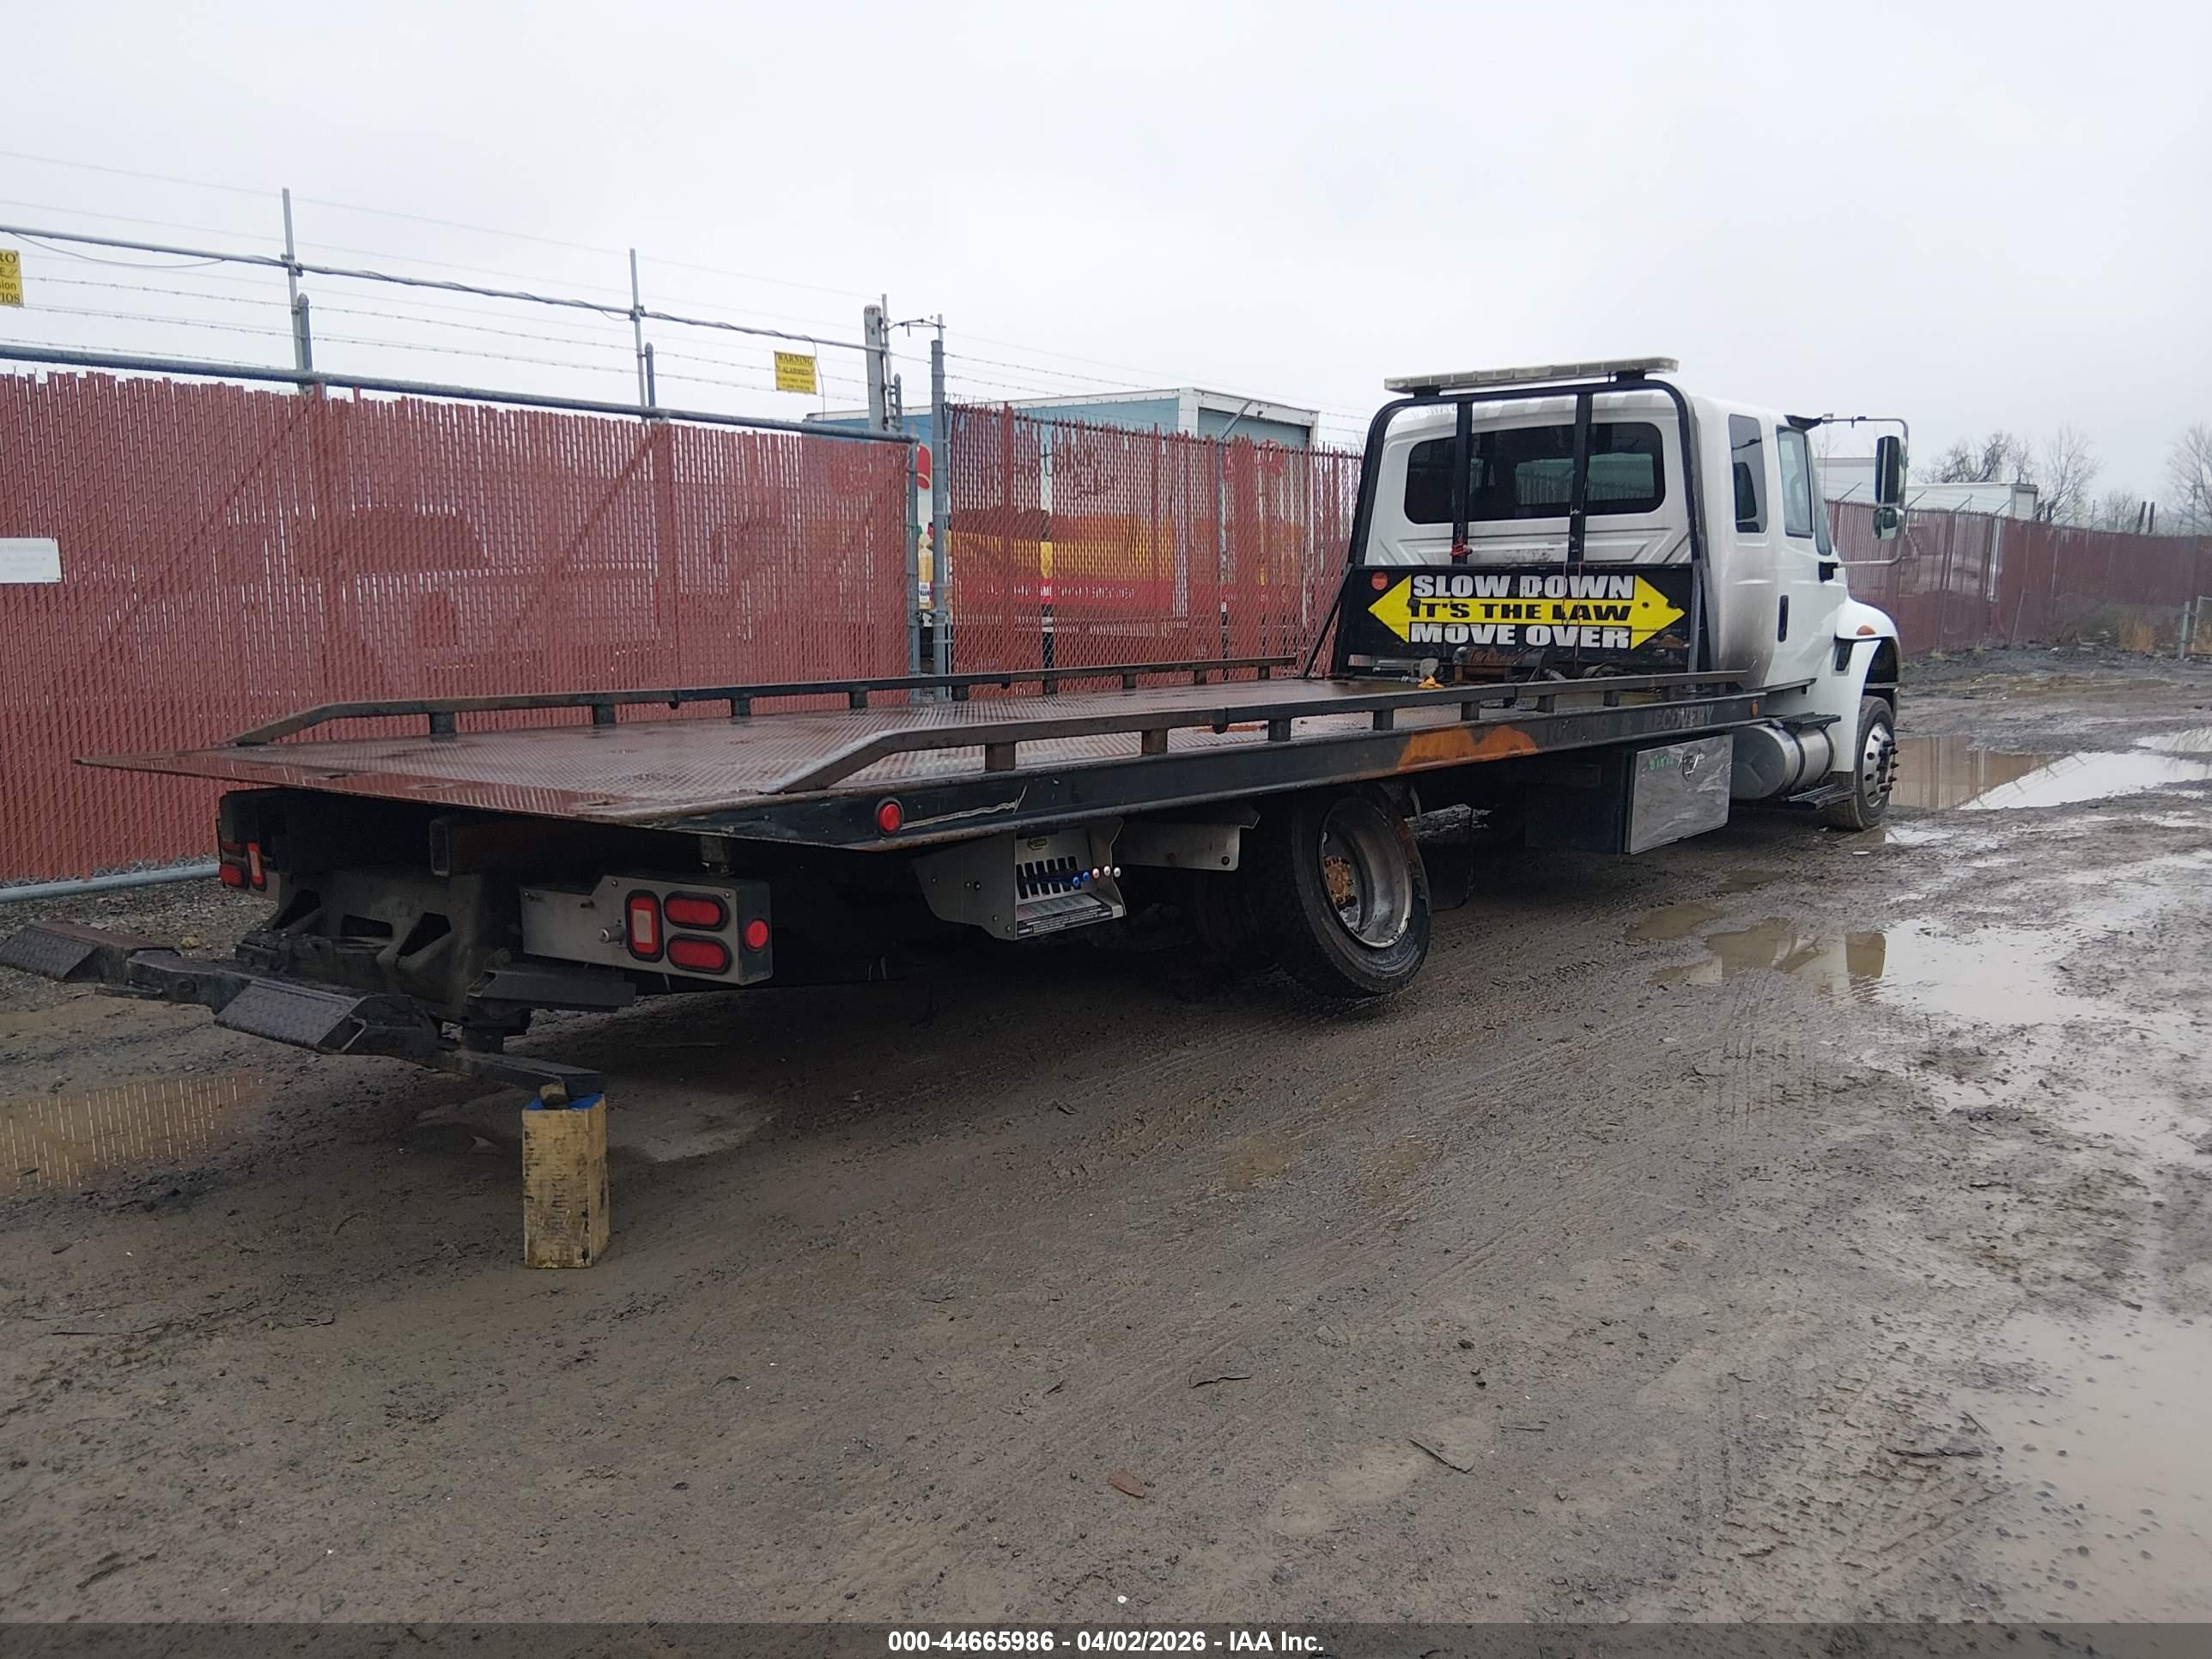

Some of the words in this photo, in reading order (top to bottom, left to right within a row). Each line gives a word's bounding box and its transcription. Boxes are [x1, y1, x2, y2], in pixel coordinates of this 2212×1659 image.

[777, 352, 813, 365] WARNING
[1413, 574, 1511, 598] SLOW
[1519, 574, 1634, 599] DOWN
[1409, 599, 1470, 618] IT'S
[1480, 603, 1541, 619] THE
[1553, 605, 1632, 621] LAW
[1411, 623, 1516, 645] MOVE
[1525, 624, 1630, 649] OVER
